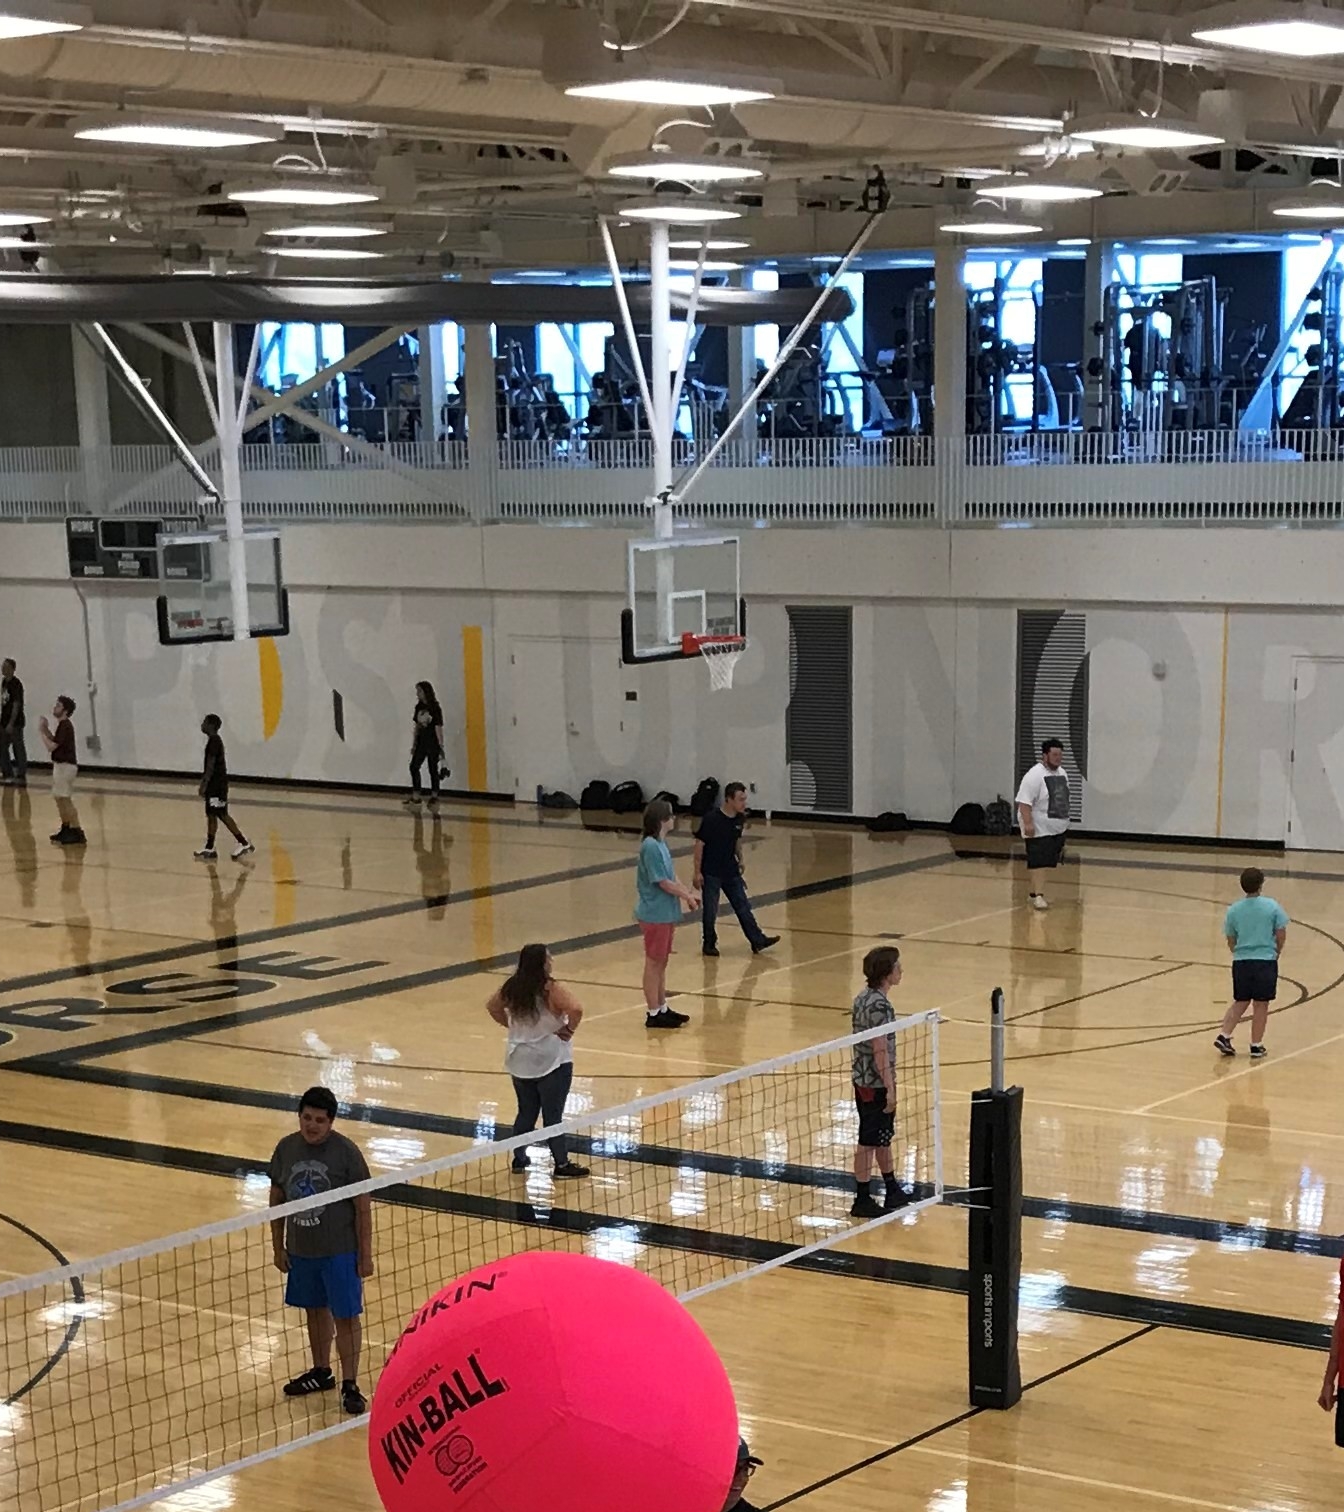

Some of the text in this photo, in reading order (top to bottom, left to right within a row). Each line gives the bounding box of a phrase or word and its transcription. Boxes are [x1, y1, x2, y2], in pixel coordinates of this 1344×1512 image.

[983, 1273, 993, 1348] sports imports
[381, 1353, 506, 1485] KIN-BALL
